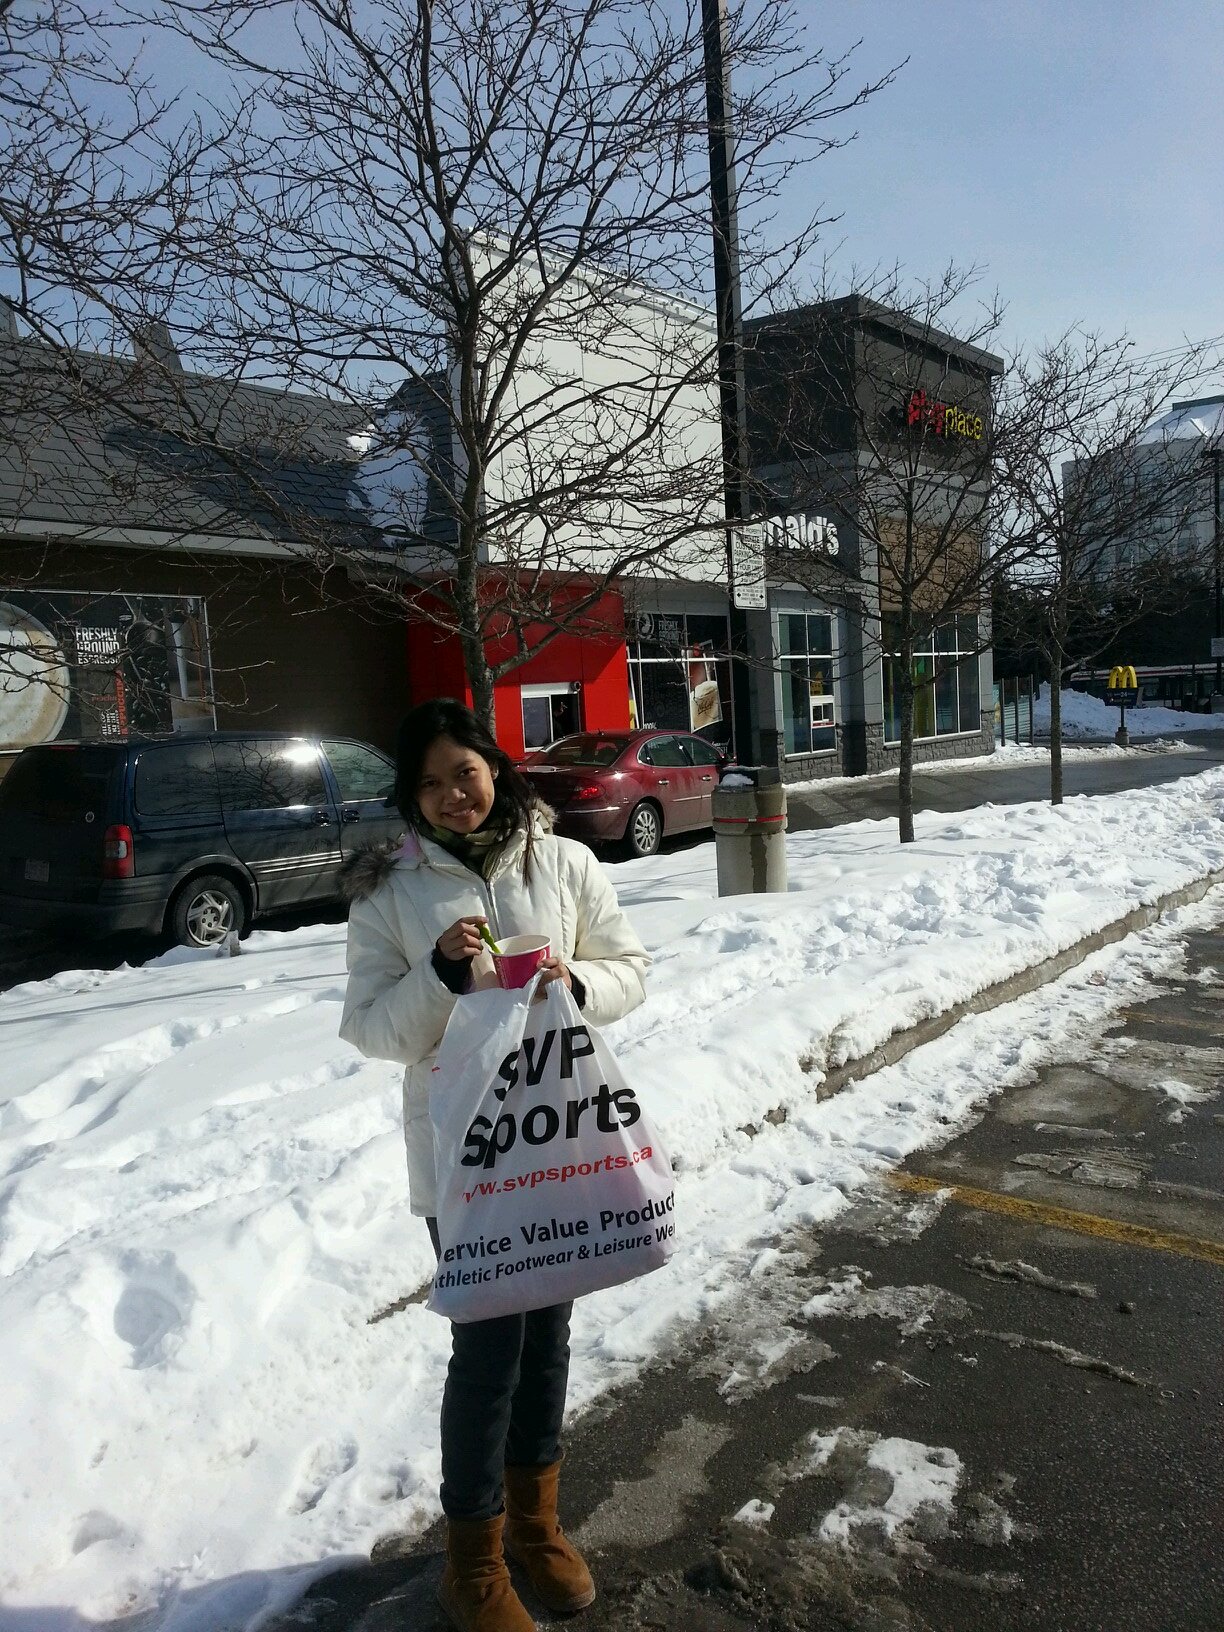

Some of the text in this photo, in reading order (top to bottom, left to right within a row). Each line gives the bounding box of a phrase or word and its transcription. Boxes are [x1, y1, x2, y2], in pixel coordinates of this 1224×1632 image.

[945, 405, 983, 440] place
[751, 513, 839, 555] nald's
[76, 627, 118, 641] FRESHLY
[77, 641, 120, 654] GROUND
[520, 1218, 589, 1245] Value
[495, 1249, 574, 1280] Footwear
[577, 1244, 590, 1260] &
[594, 1230, 652, 1258] Leisure
[655, 1221, 676, 1243] We
